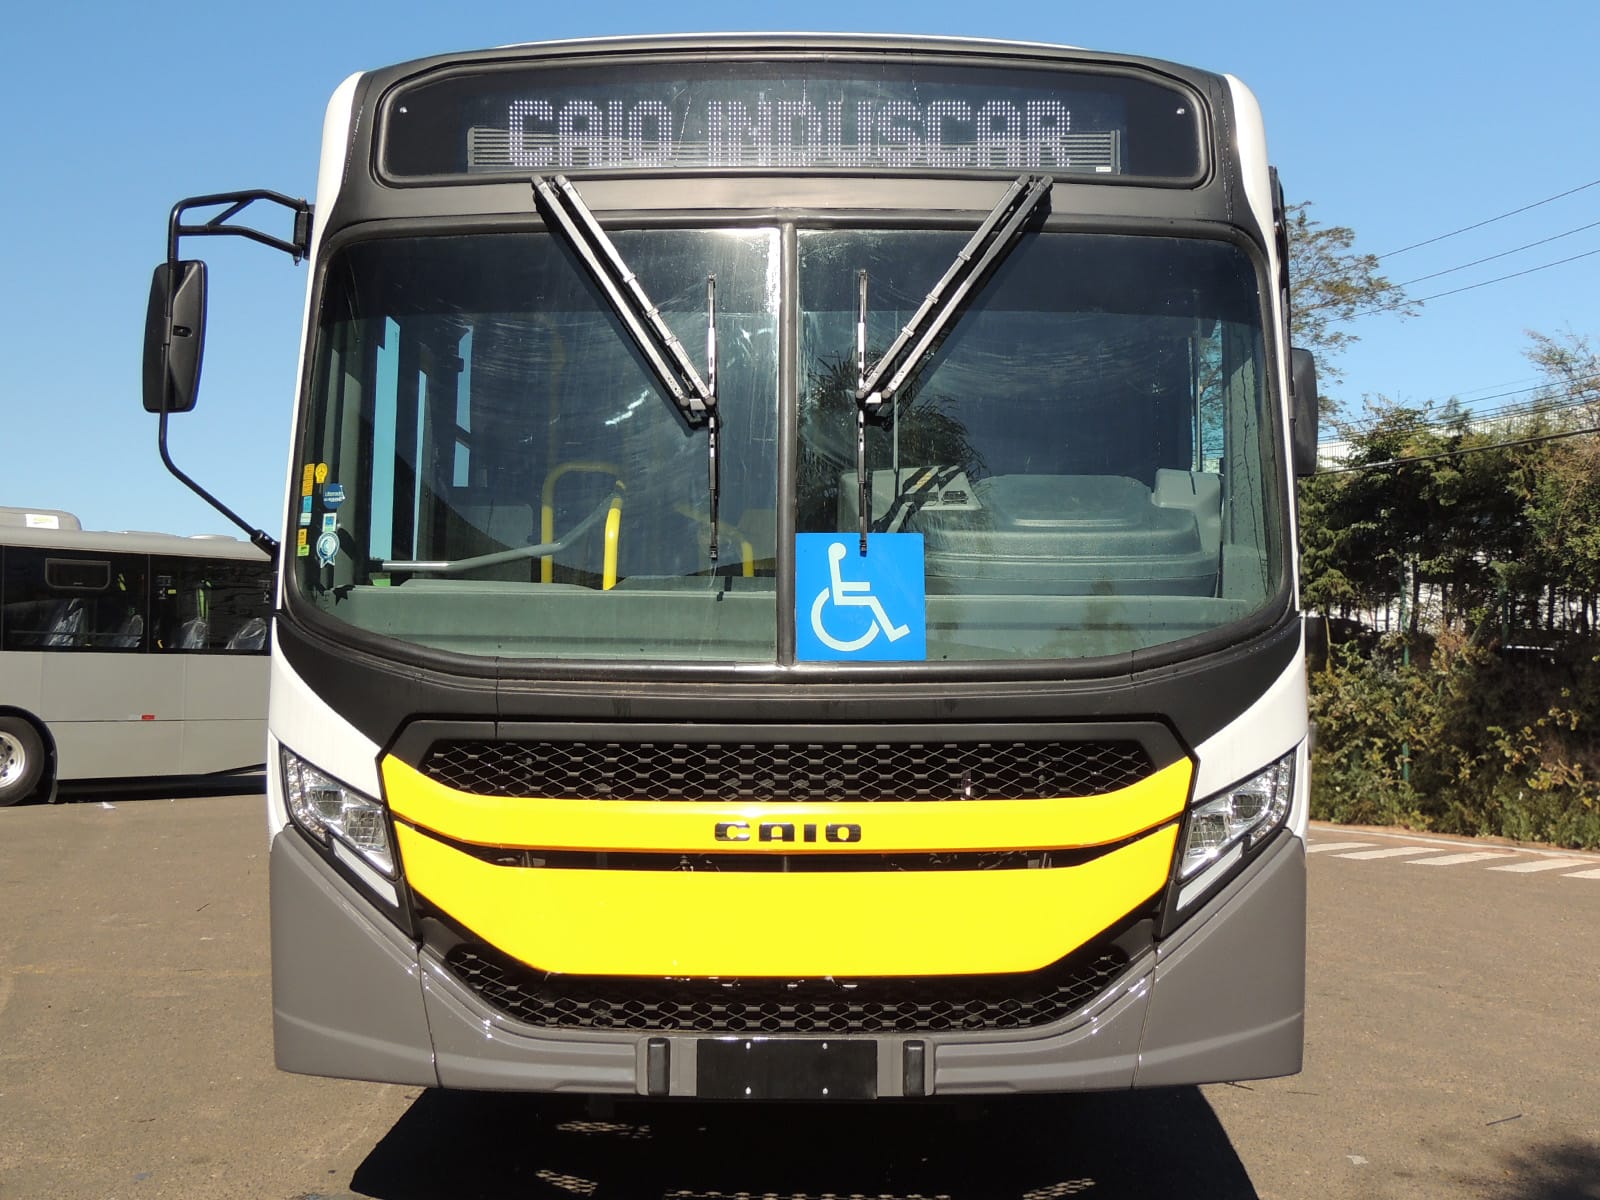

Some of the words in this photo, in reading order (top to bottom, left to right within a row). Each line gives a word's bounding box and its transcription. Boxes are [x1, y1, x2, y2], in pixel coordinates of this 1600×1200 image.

[508, 100, 673, 167] CAIO
[707, 100, 1072, 168] INDUSCAR
[714, 822, 862, 843] CAIO
